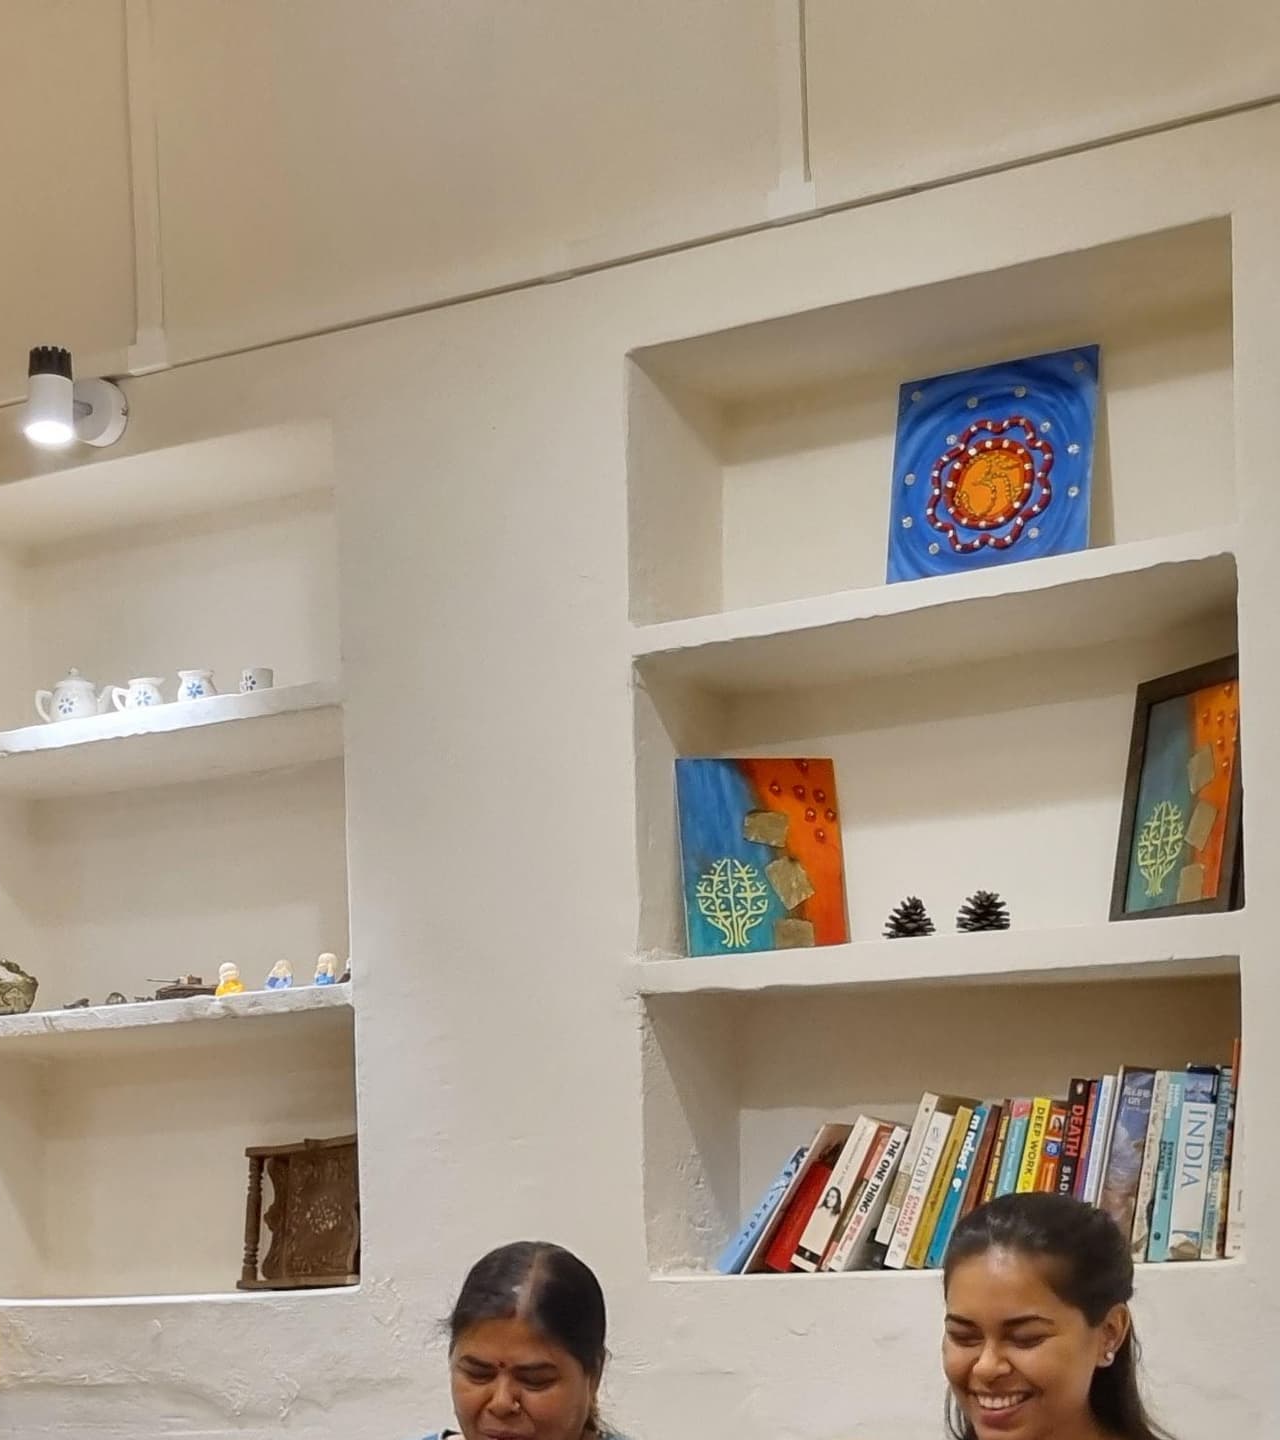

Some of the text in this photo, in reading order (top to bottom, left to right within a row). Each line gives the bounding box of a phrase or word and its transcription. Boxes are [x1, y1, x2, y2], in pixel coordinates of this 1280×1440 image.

[884, 1138, 901, 1158] THE
[957, 1113, 981, 1172] mndset
[1024, 1106, 1045, 1175] DEEP WORK
[1065, 1103, 1085, 1157] DEATH
[873, 1158, 891, 1181] ONE
[913, 1146, 934, 1194] HABIT
[1058, 1165, 1071, 1195] SAD
[858, 1182, 879, 1214] THING
